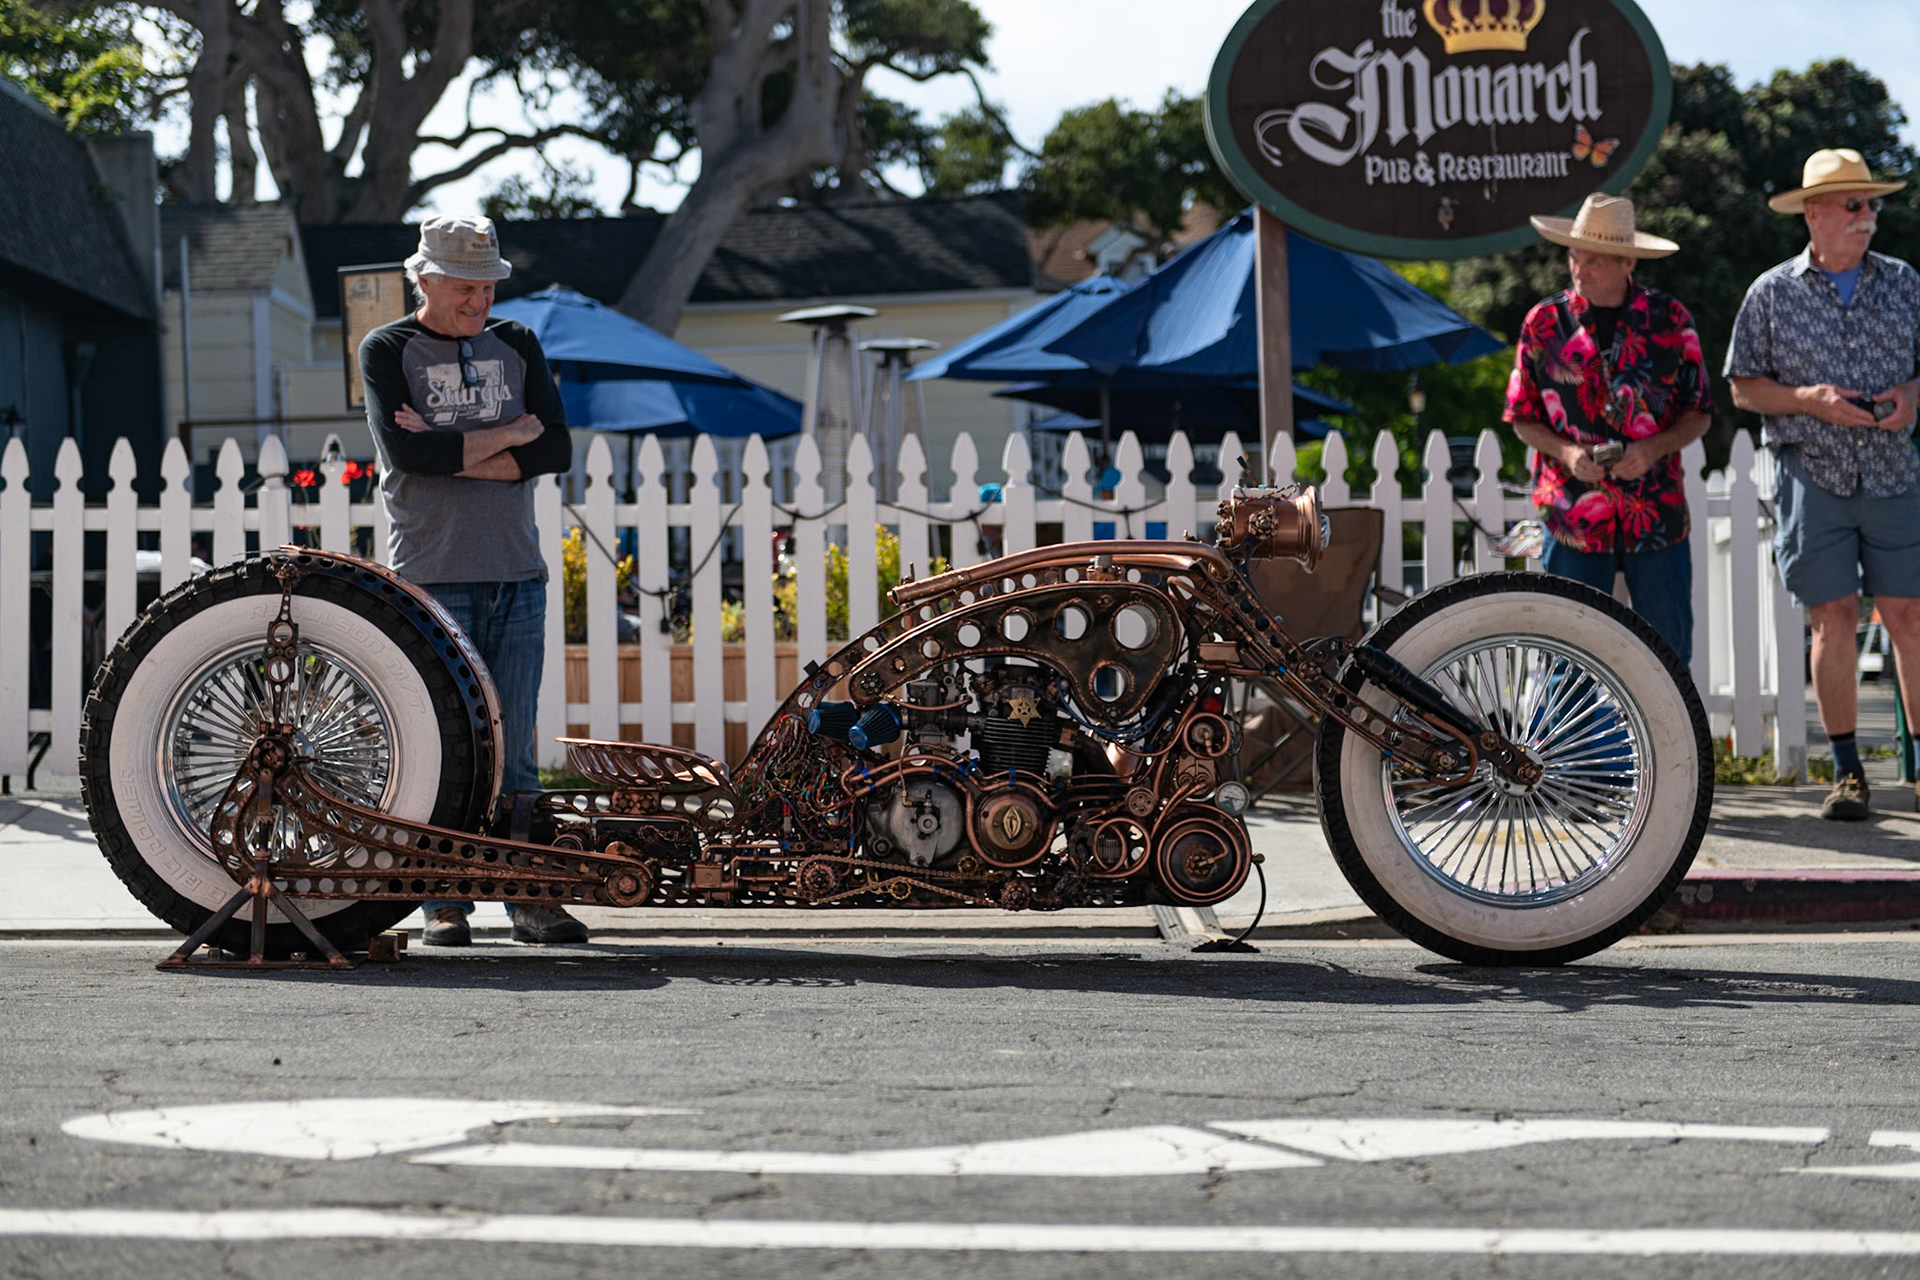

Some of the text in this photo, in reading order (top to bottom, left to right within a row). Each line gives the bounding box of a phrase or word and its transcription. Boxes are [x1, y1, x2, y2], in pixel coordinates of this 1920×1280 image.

[1381, 0, 1417, 38] the
[1254, 27, 1603, 167] Monarch
[1413, 151, 1435, 187] &
[426, 378, 513, 409] Sturgis
